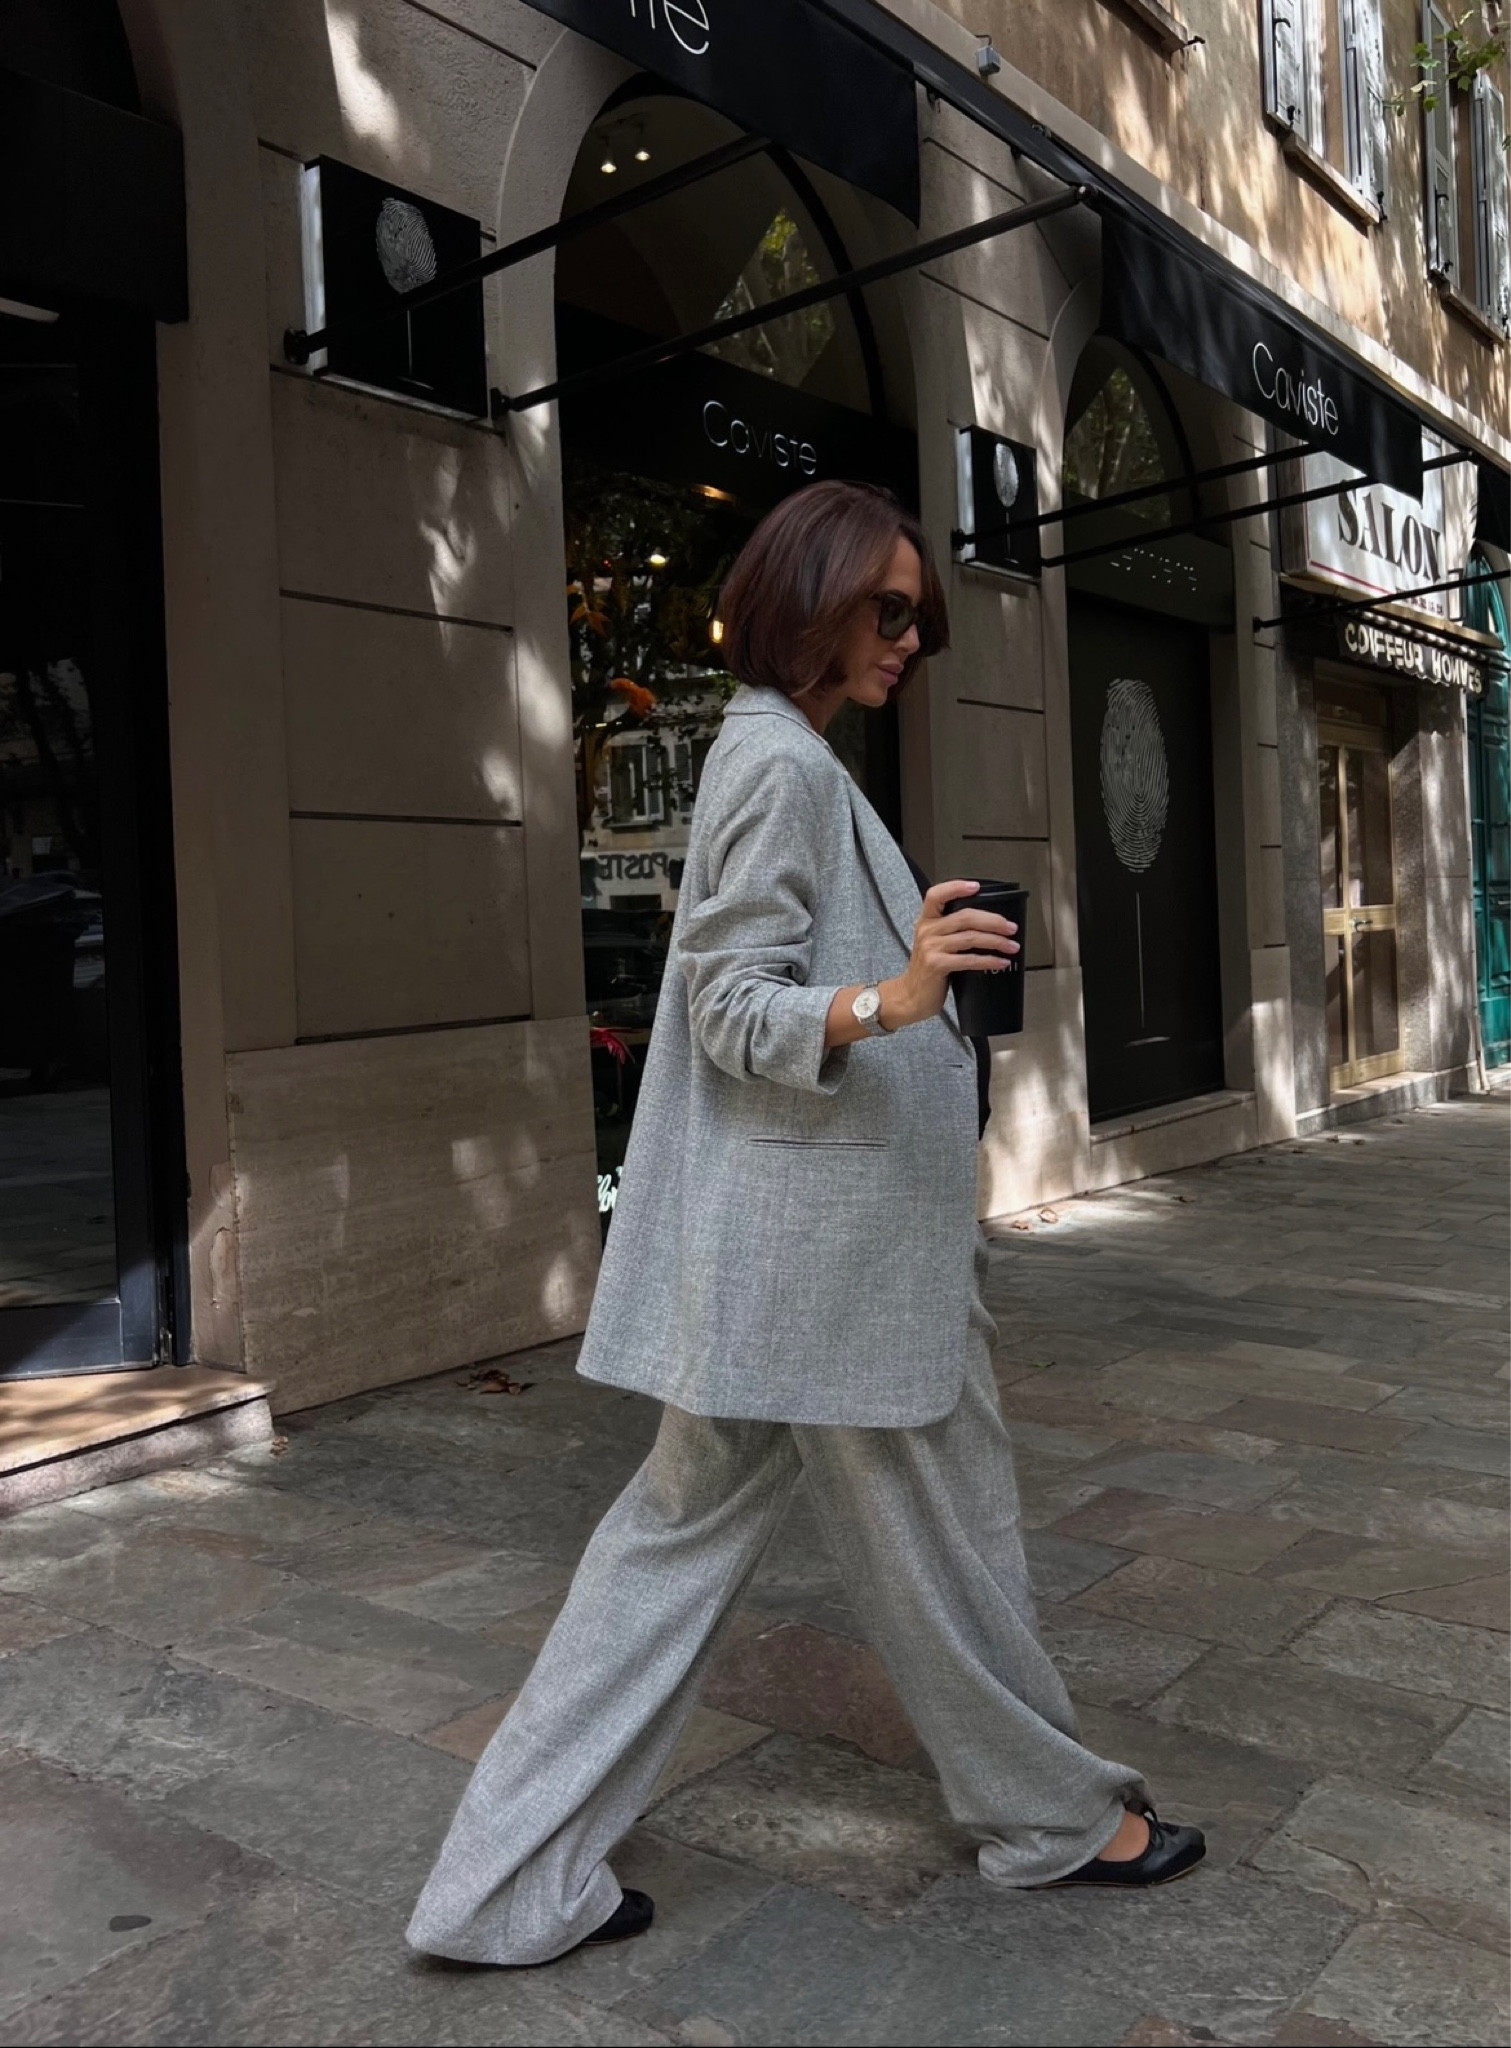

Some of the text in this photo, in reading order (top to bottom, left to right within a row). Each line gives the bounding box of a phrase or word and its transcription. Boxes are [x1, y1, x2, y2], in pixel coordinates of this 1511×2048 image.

[1252, 342, 1339, 436] Caviste
[702, 400, 817, 475] Caviste
[1337, 479, 1441, 585] SALON
[1345, 622, 1482, 693] COIFFEUR HOMMES
